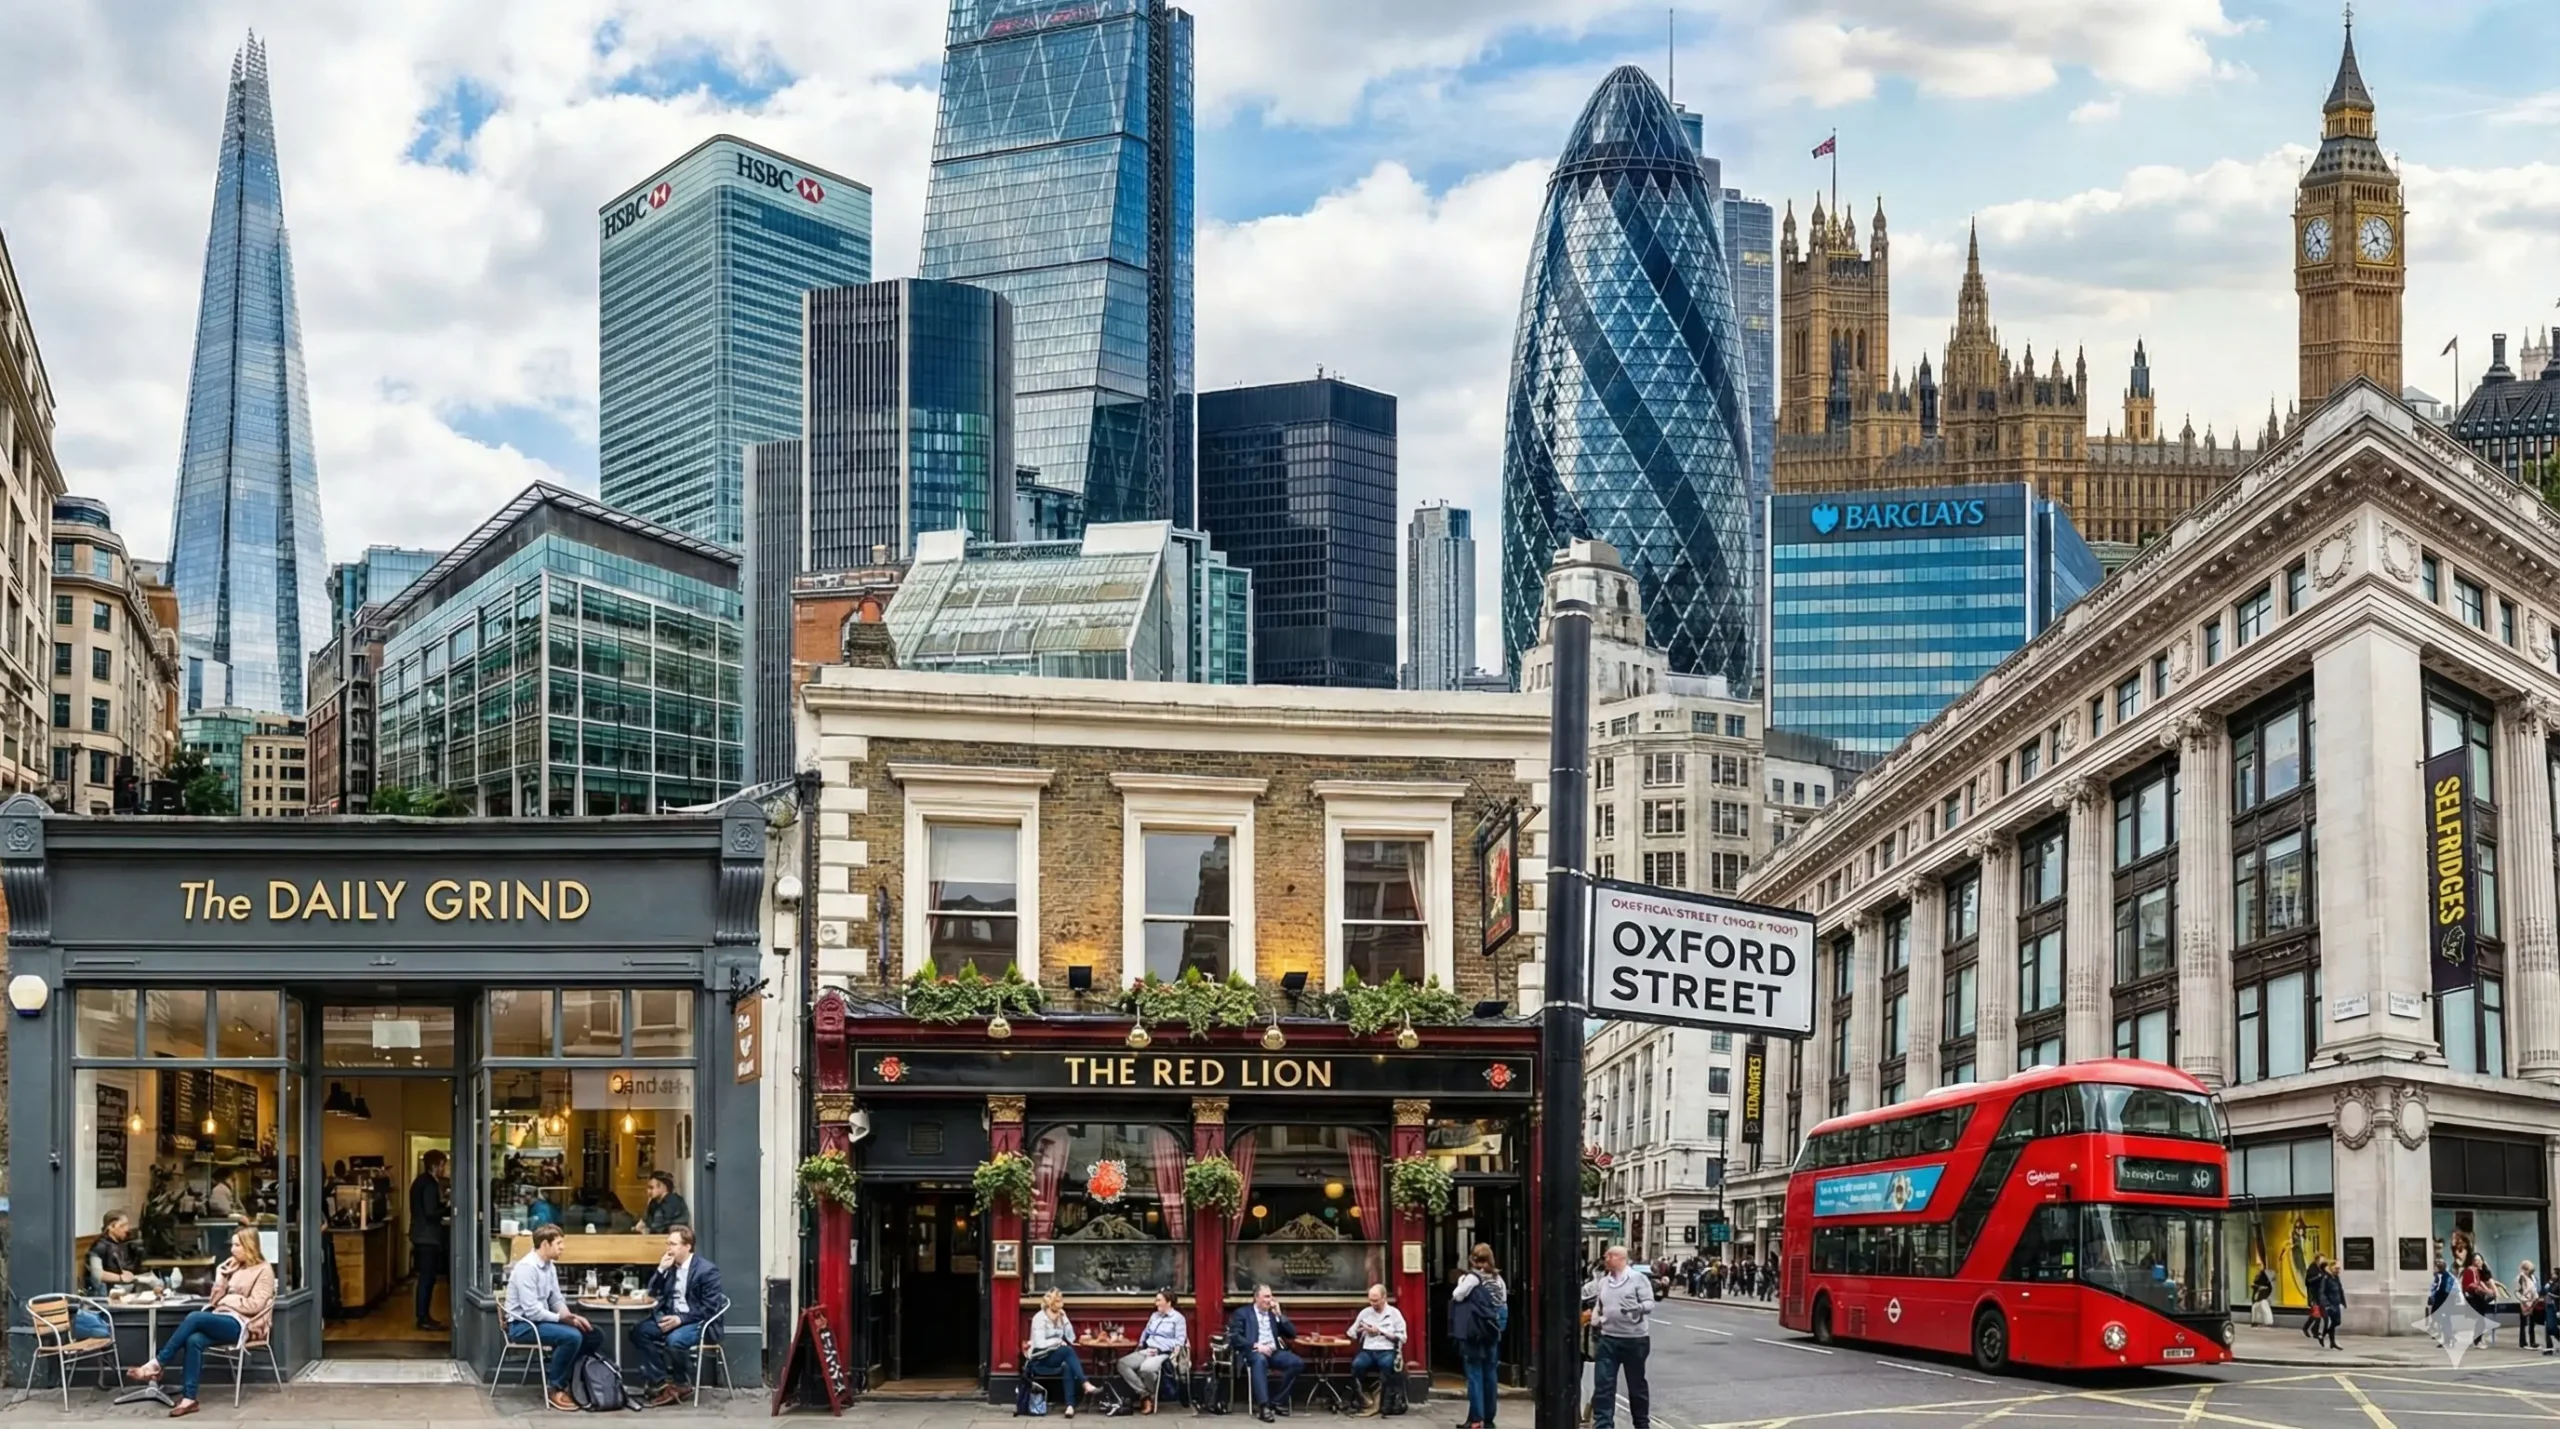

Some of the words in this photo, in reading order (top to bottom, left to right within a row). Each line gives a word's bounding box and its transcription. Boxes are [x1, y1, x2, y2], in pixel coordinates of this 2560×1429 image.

[737, 152, 794, 193] HSBC
[604, 194, 648, 239] HSBC
[1845, 500, 1984, 530] BARCLAYS
[2434, 776, 2465, 925] SELFRIDGES
[180, 880, 252, 920] The
[268, 880, 407, 920] DAILY
[424, 880, 591, 921] GRIND
[1612, 921, 1796, 977] OXFORD
[1610, 966, 1782, 1018] STREET
[1064, 1058, 1136, 1085] THE
[1153, 1059, 1225, 1086] RED
[1241, 1060, 1331, 1087] LION
